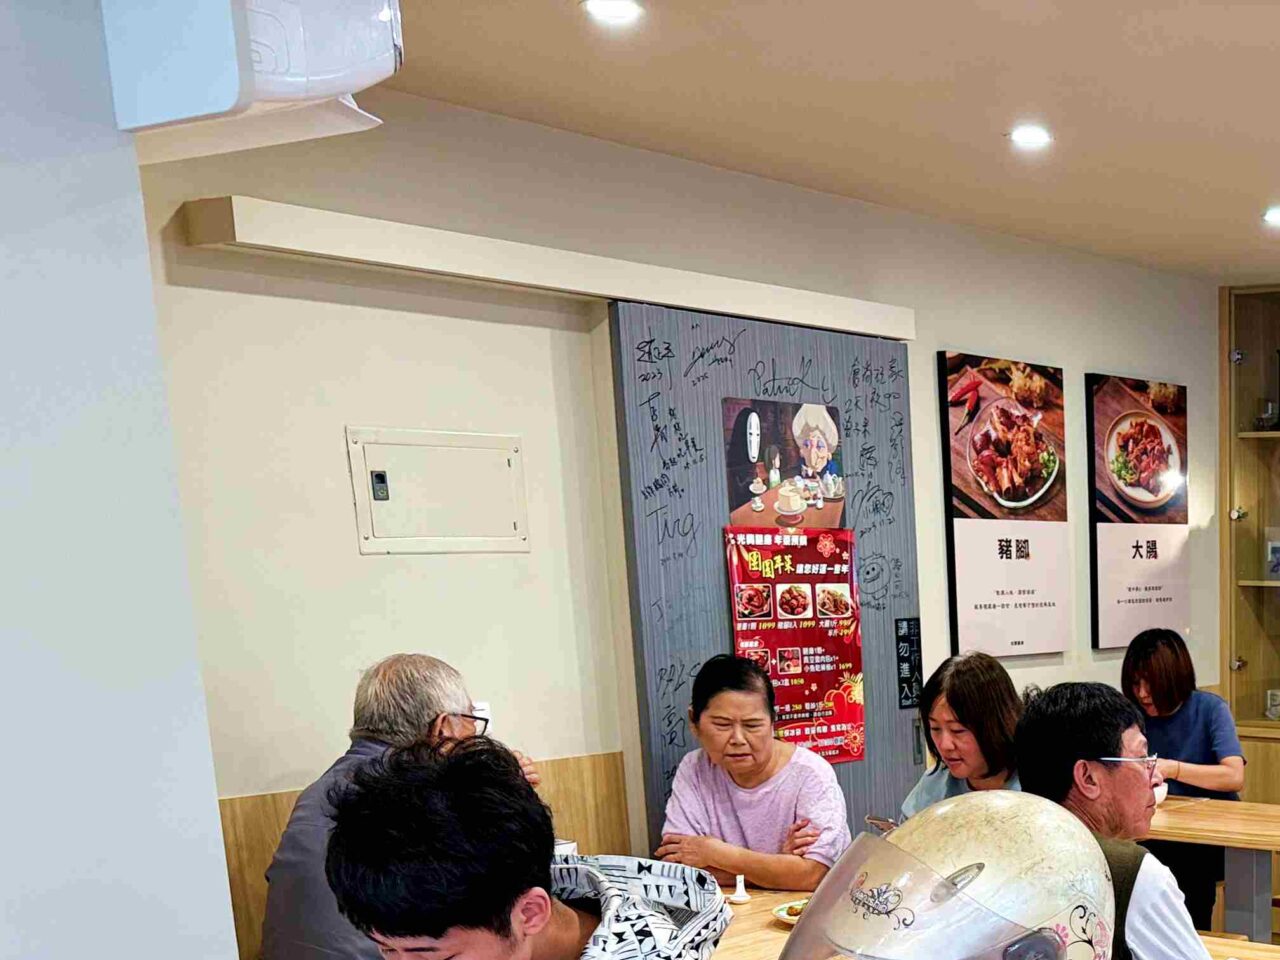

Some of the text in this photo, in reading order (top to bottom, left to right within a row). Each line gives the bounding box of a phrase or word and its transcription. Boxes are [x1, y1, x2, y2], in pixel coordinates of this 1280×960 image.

[997, 538, 1030, 560] 豬腳
[1132, 539, 1158, 560] 大腸
[897, 620, 912, 698] 請勿進入
